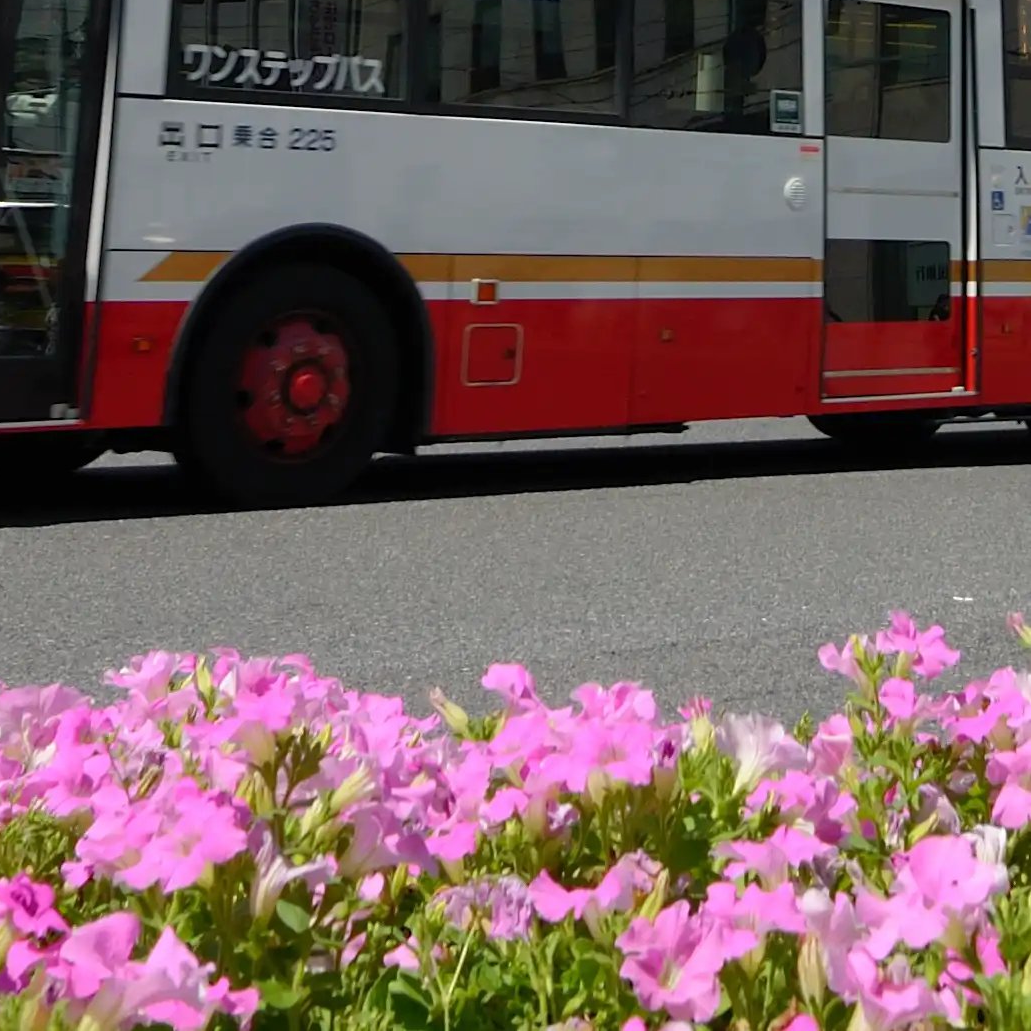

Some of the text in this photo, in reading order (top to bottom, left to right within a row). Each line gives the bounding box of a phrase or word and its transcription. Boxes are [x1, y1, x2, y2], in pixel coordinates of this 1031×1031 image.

[183, 43, 385, 94] ワンステップバス
[158, 122, 221, 149] 出口
[288, 127, 336, 152] 225
